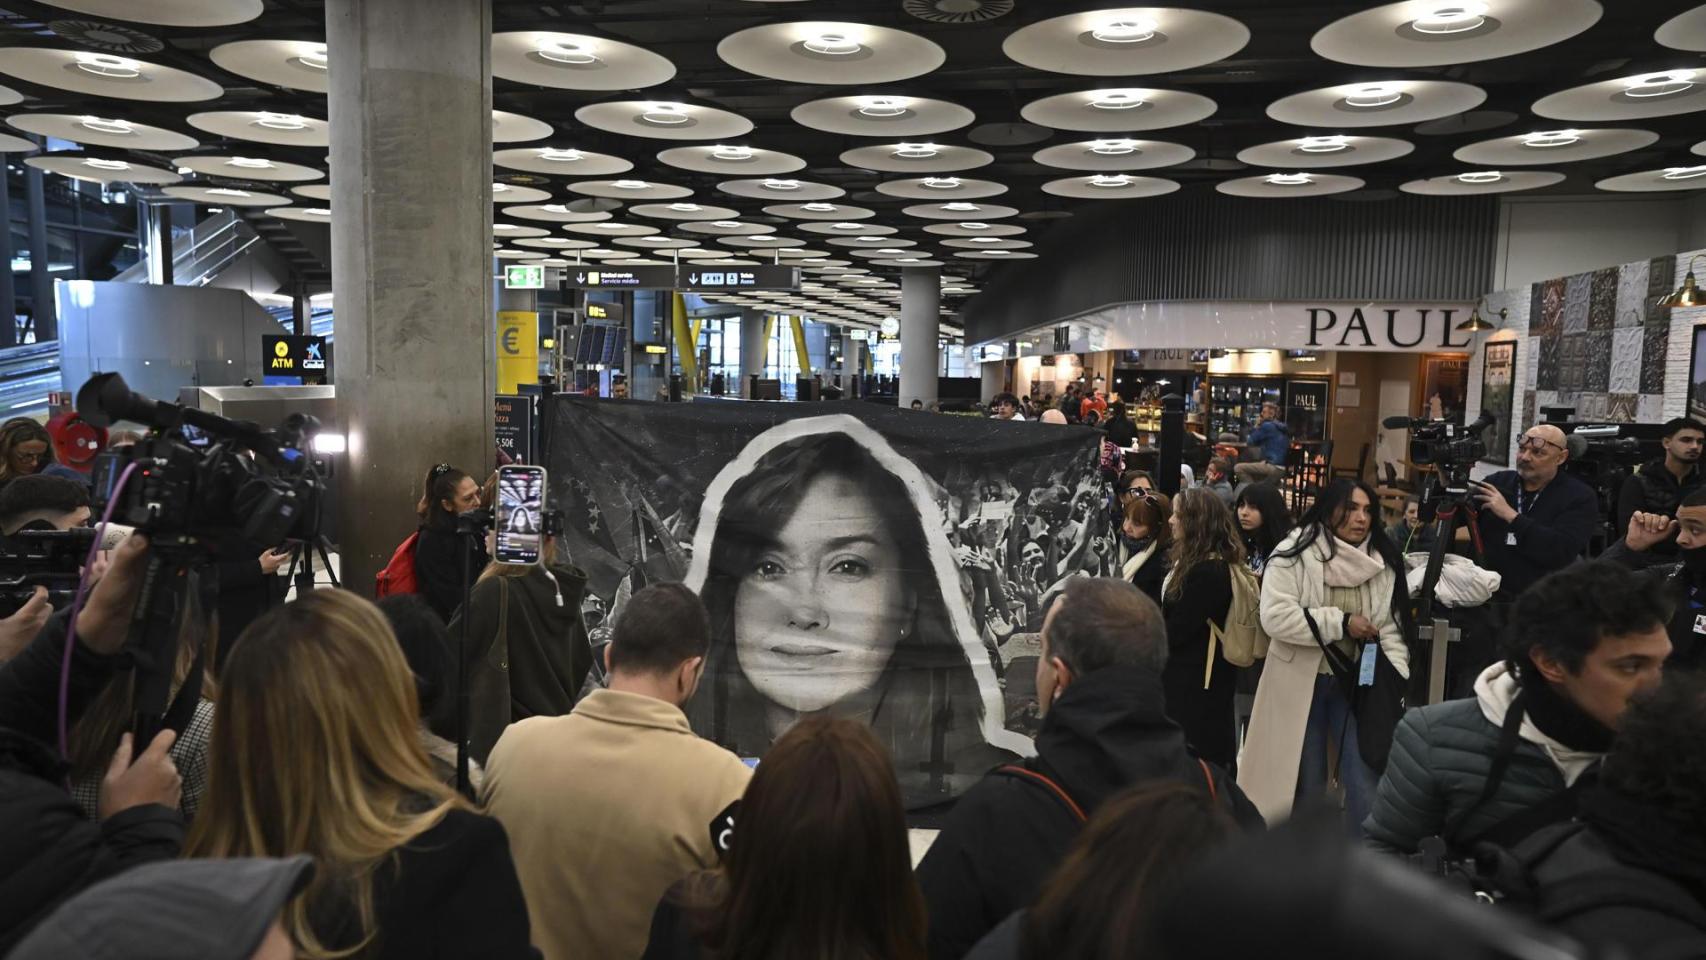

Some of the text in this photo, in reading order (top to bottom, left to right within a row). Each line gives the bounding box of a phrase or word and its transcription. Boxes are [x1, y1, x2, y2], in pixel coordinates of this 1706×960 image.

[1305, 308, 1472, 348] PAUL
[502, 327, 520, 355] €
[271, 358, 293, 368] ATM
[1295, 394, 1317, 407] PAUL
